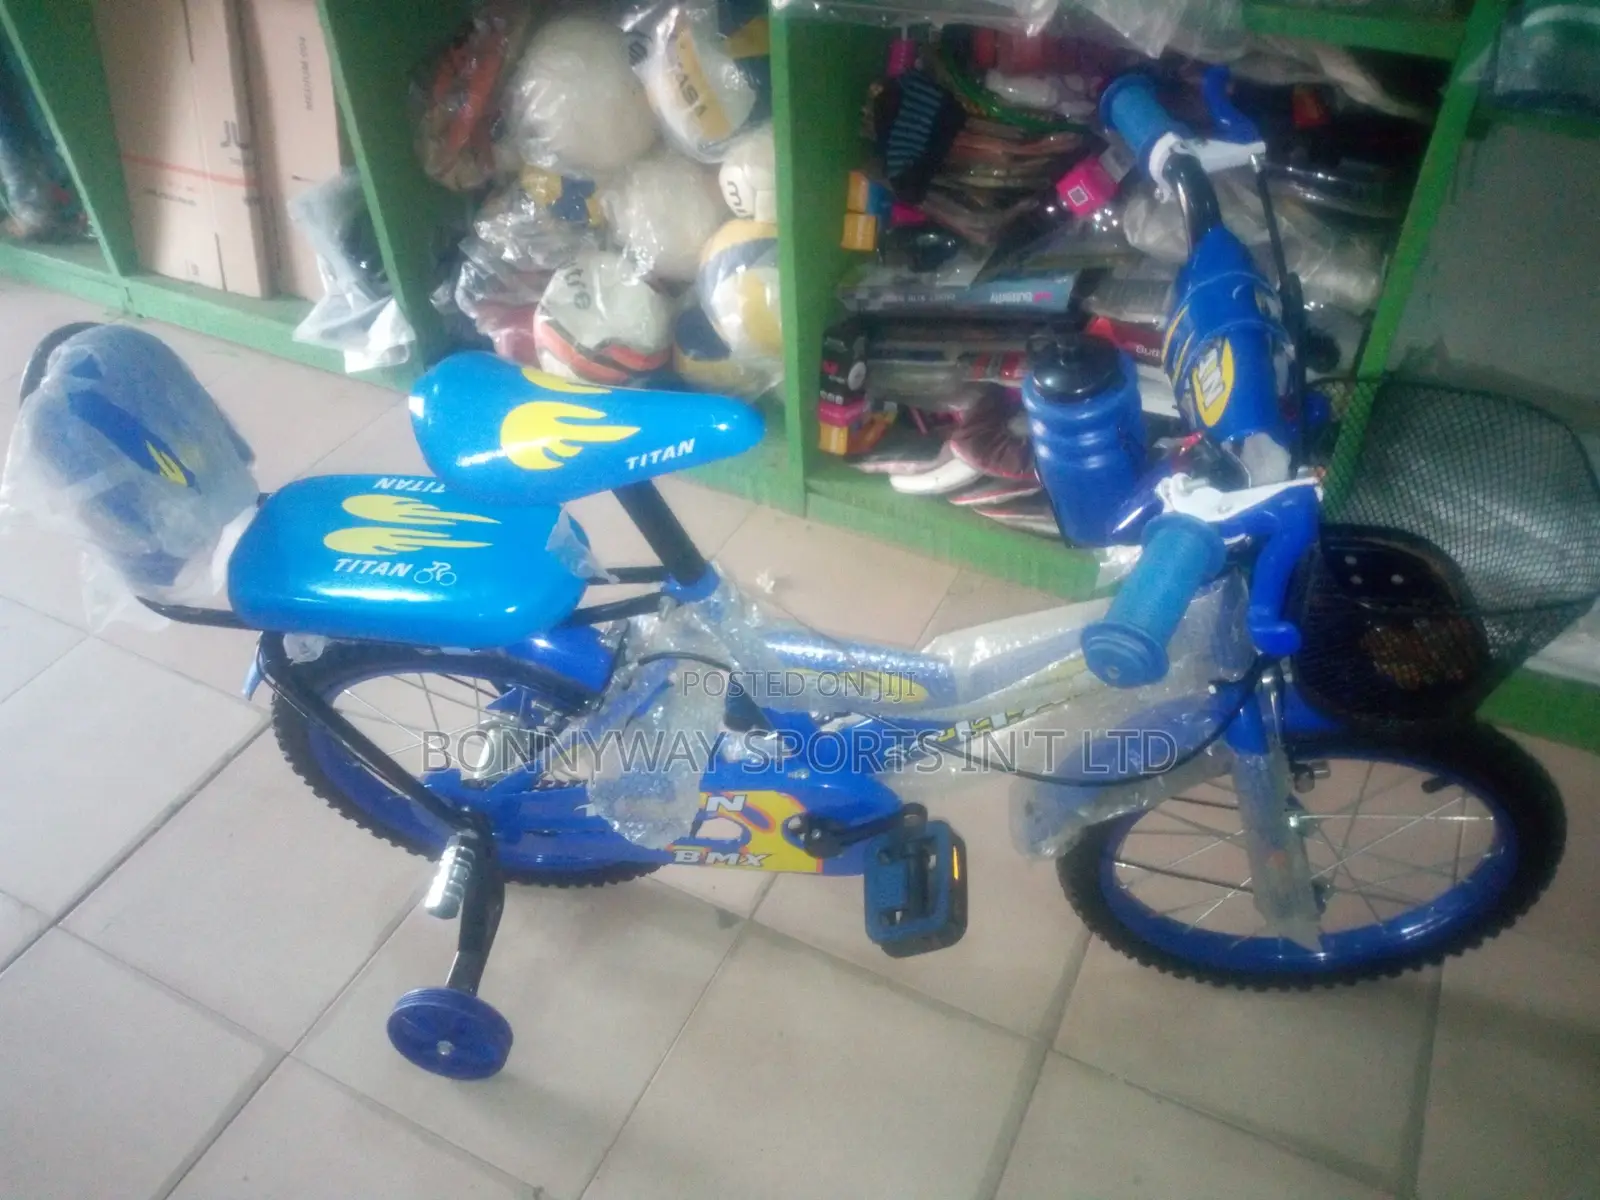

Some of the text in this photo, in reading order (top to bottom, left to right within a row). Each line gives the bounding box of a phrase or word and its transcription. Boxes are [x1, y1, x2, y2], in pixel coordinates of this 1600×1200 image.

[625, 438, 697, 470] TITAN
[373, 477, 446, 493] TITAN
[333, 558, 413, 577] TITAN
[673, 850, 771, 868] BMX
